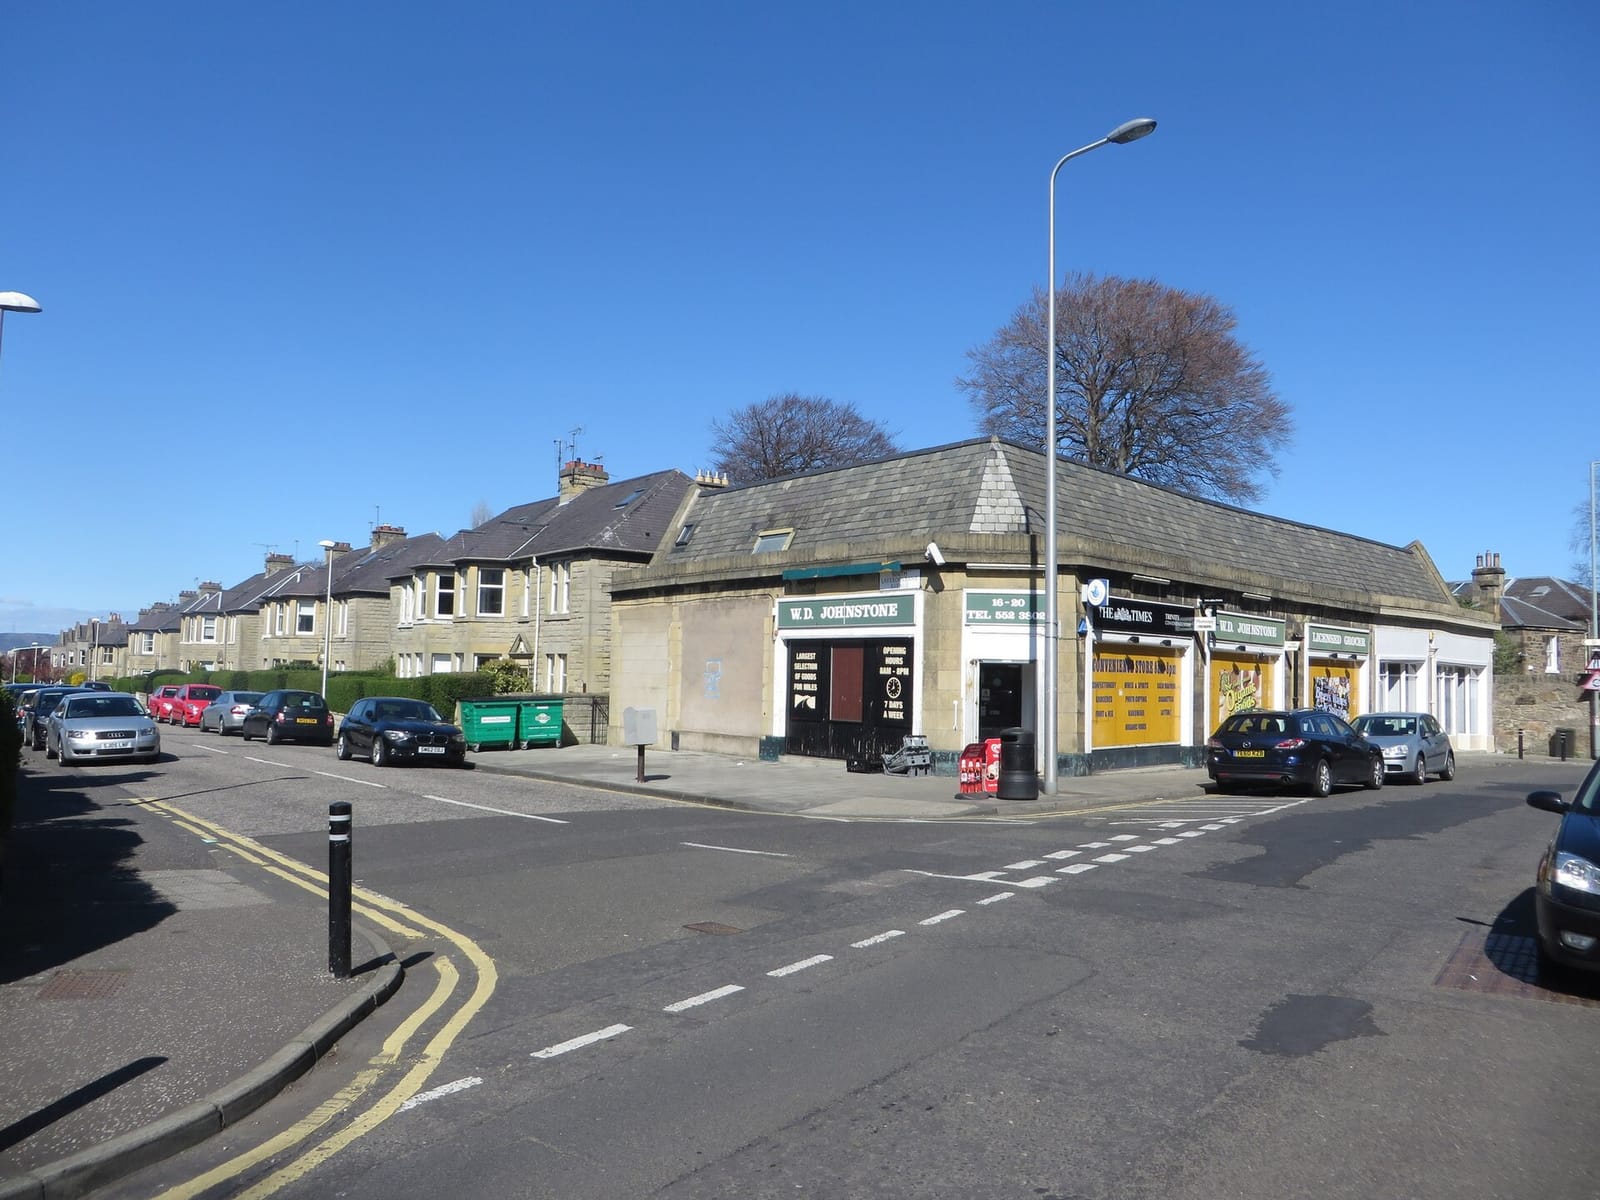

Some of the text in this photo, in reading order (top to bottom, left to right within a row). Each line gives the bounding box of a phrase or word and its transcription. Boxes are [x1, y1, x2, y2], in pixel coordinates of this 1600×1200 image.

[790, 603, 898, 620] W.D. JOHNSTONE
[967, 610, 991, 620] TEL
[995, 611, 1015, 620] 552
[1099, 606, 1152, 623] THE TIMES
[1220, 620, 1234, 633] W.D.
[1237, 622, 1277, 638] JOHNSTONE
[883, 646, 906, 655] OPENING
[796, 652, 816, 660] LARGEST
[885, 656, 903, 665] HOURS
[794, 662, 818, 670] SELECTION
[1135, 660, 1153, 674] STORE
[794, 672, 817, 681] OF GOODS
[794, 683, 817, 691] FOR MILES
[884, 701, 903, 709] 7 DAYS
[883, 710, 904, 719] A WEEK
